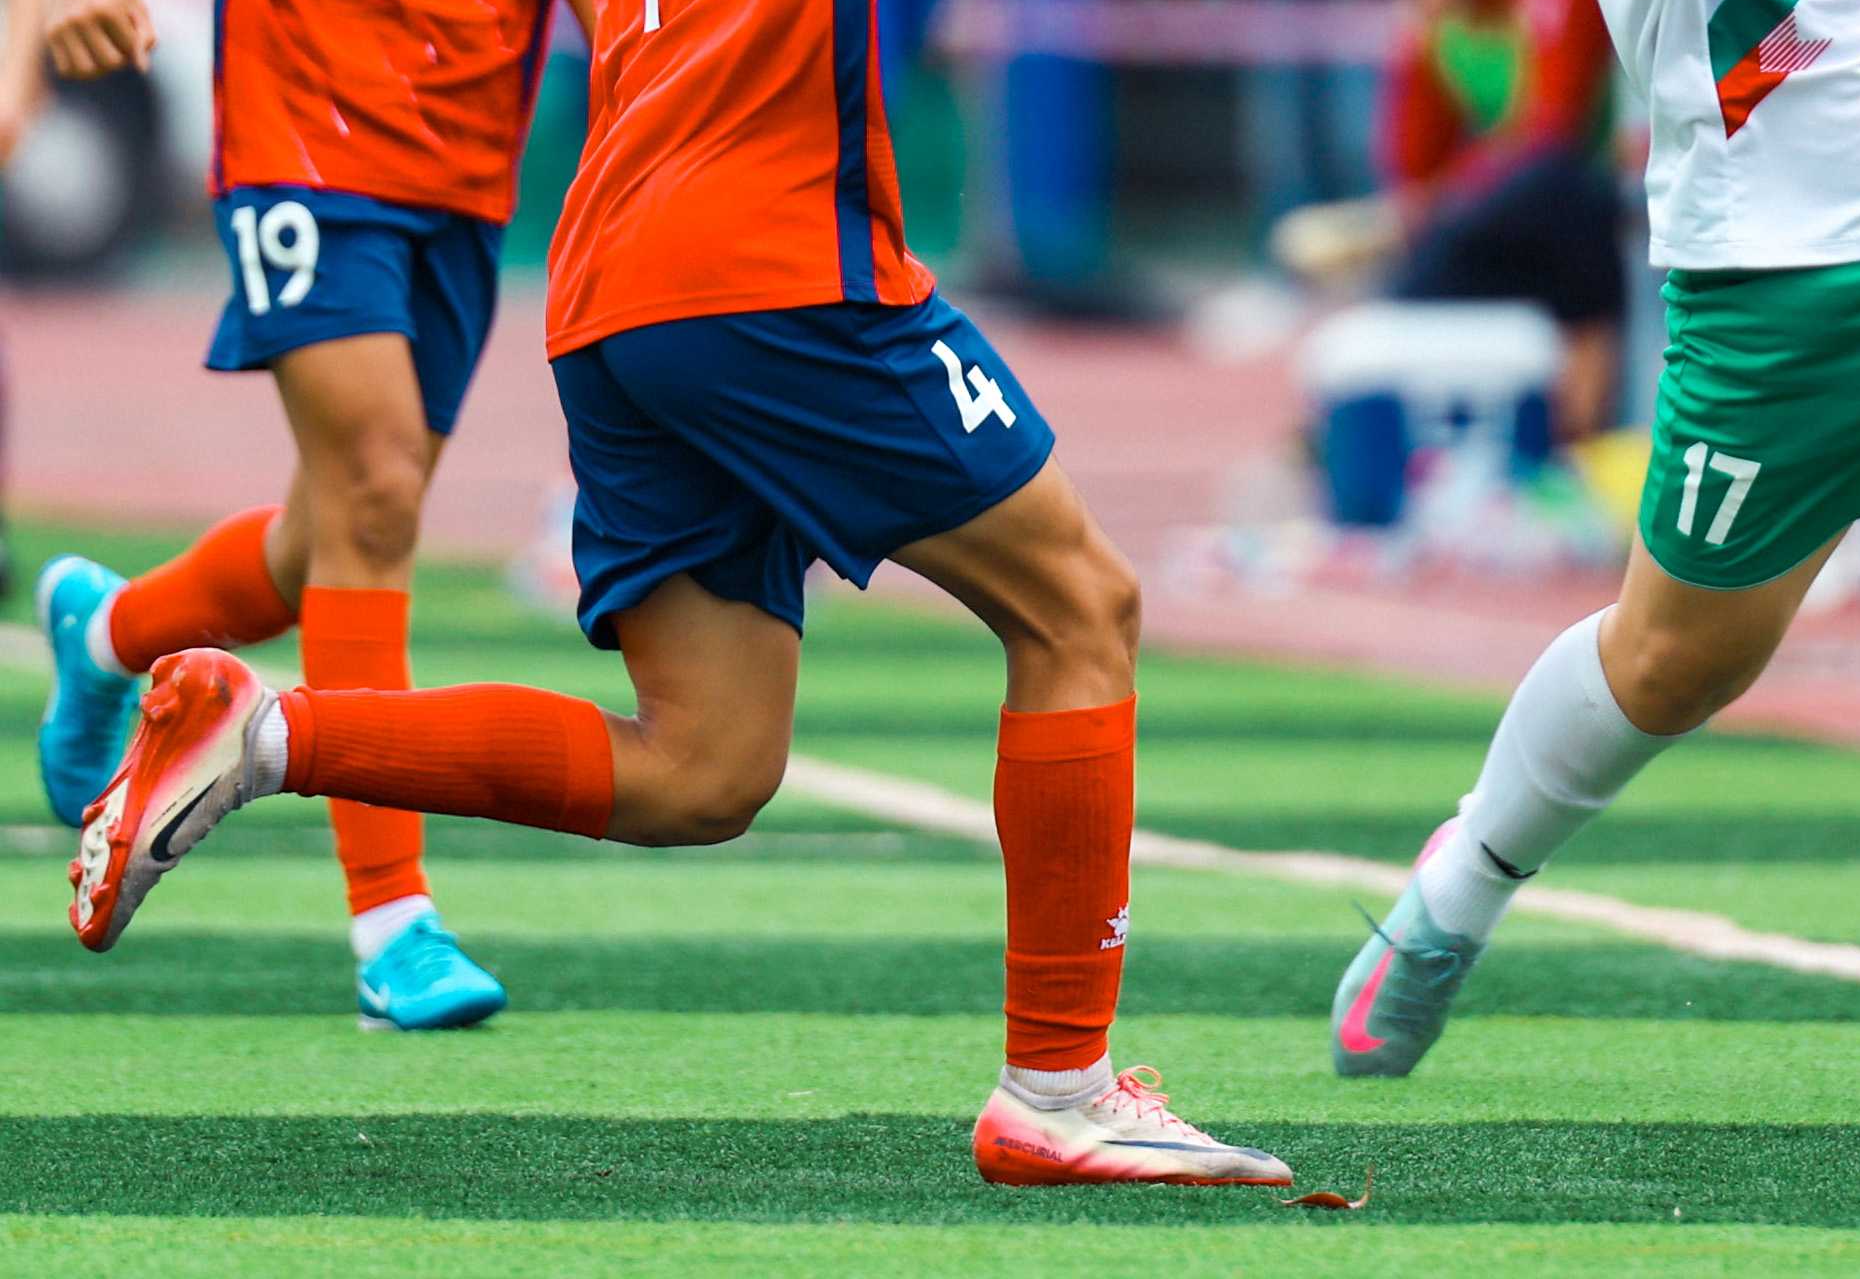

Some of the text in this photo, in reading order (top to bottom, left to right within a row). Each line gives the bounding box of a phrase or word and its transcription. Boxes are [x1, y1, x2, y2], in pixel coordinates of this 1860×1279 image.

[232, 201, 320, 314] 19
[931, 339, 1018, 433] 4
[1677, 442, 1761, 545] 17
